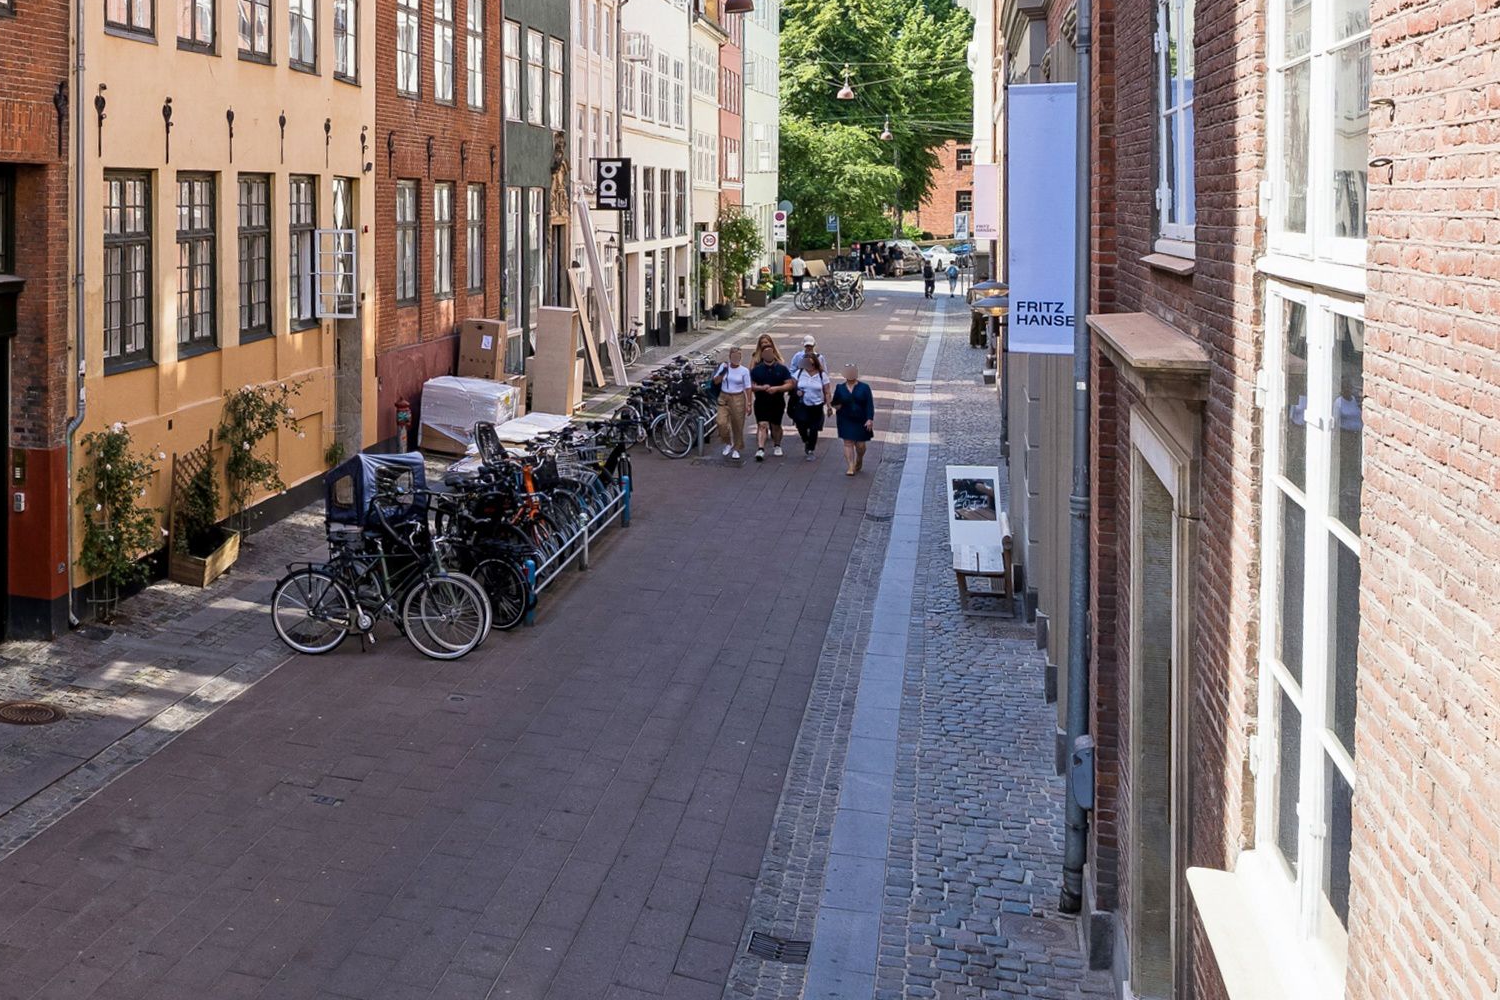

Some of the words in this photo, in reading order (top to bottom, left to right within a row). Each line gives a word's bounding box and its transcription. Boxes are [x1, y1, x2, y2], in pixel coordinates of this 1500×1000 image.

[600, 161, 622, 207] bar
[1017, 301, 1065, 313] FRITZ
[1017, 314, 1075, 327] HANSE
